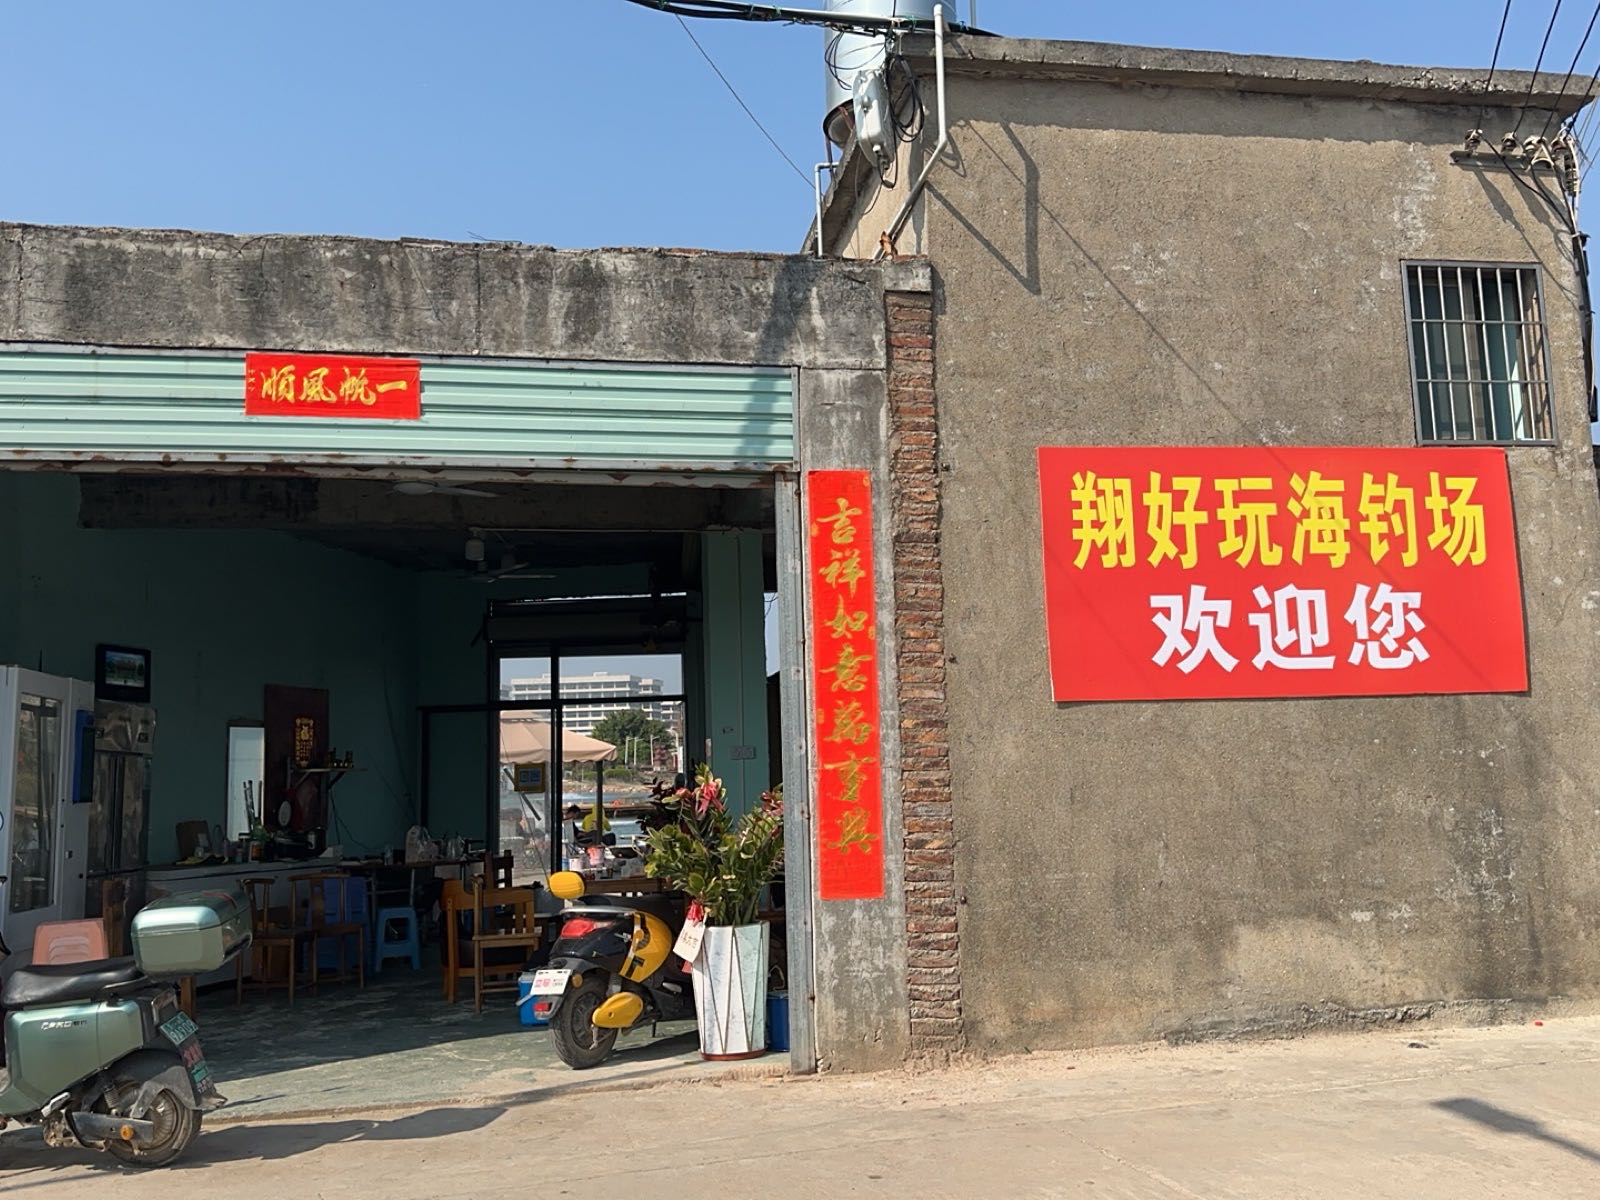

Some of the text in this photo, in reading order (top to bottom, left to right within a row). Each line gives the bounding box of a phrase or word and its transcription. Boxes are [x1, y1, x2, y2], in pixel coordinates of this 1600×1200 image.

[1070, 470, 1488, 570] 翔好玩海钓场
[1149, 583, 1431, 674] 欢迎您
